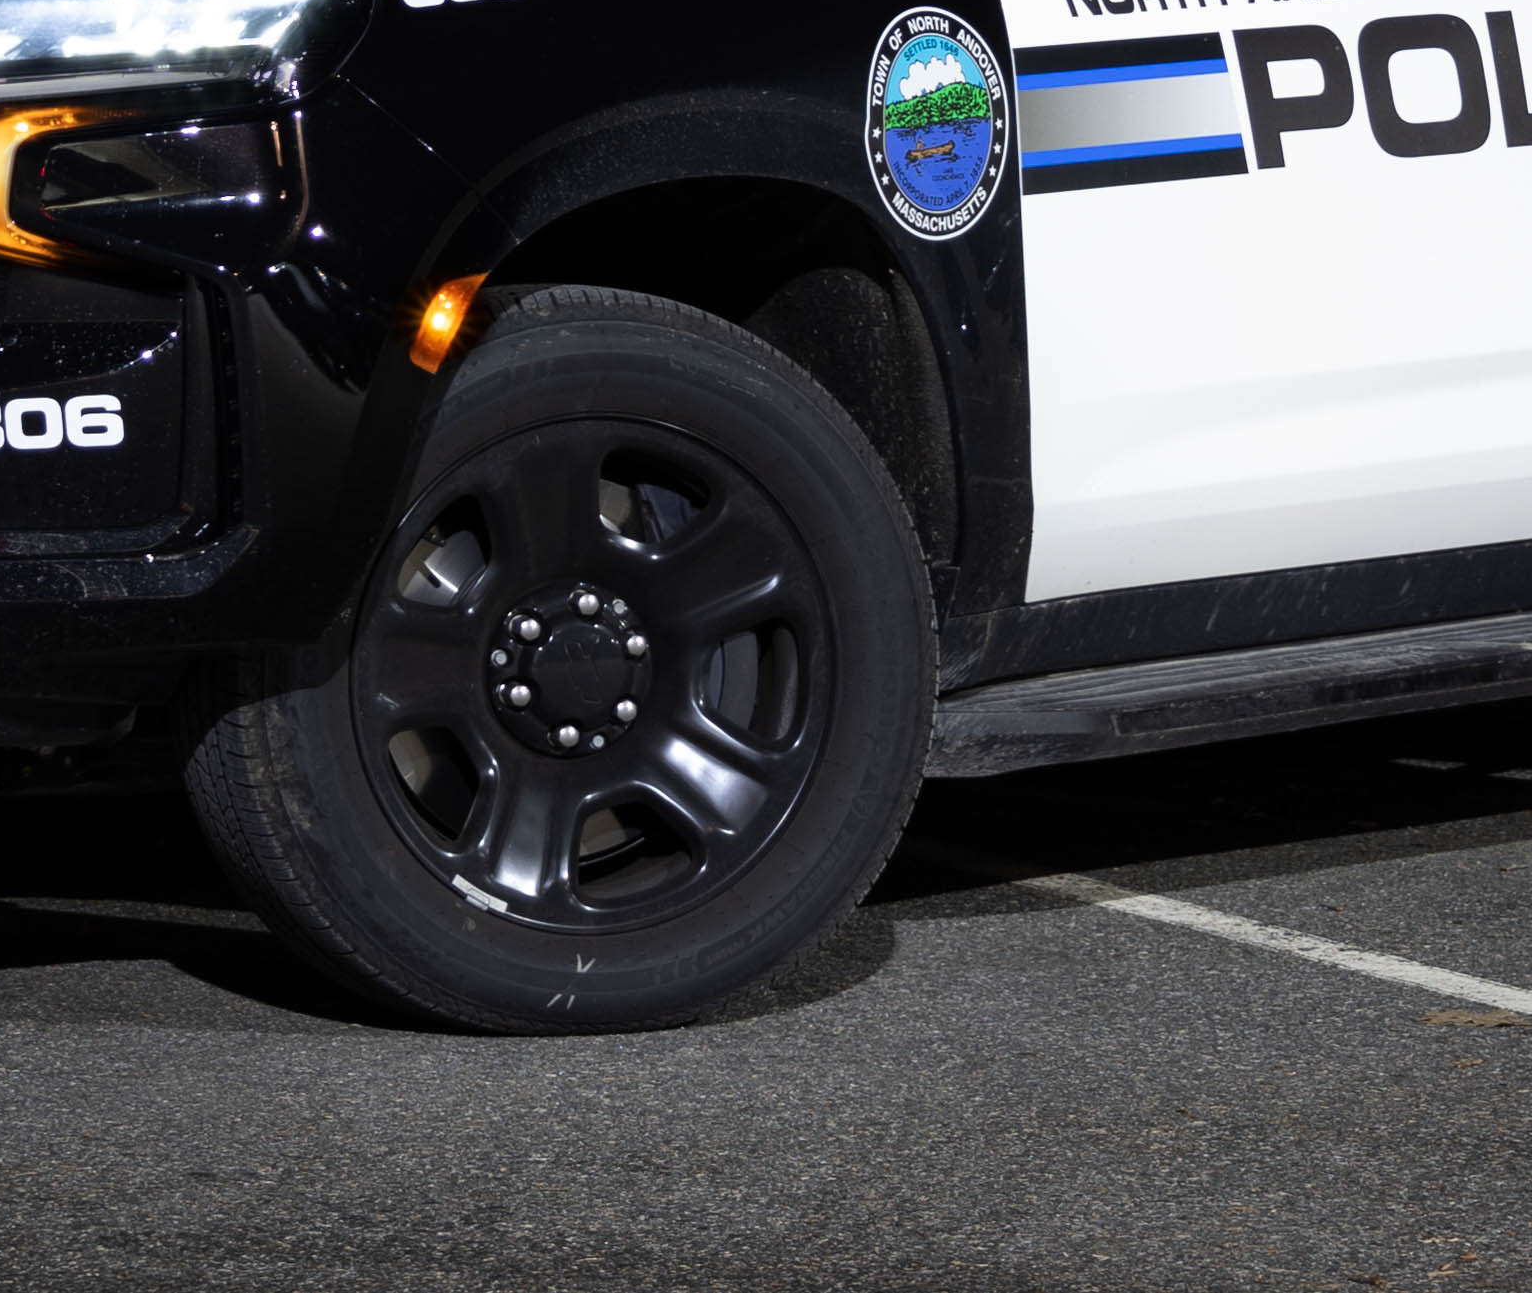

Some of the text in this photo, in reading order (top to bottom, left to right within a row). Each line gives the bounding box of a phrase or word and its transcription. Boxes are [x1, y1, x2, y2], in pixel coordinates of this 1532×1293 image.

[872, 16, 1002, 107] TOWN OF NORTH ANDOVER
[904, 39, 937, 61] SETTLED
[892, 186, 987, 232] MASSACHUSETTS
